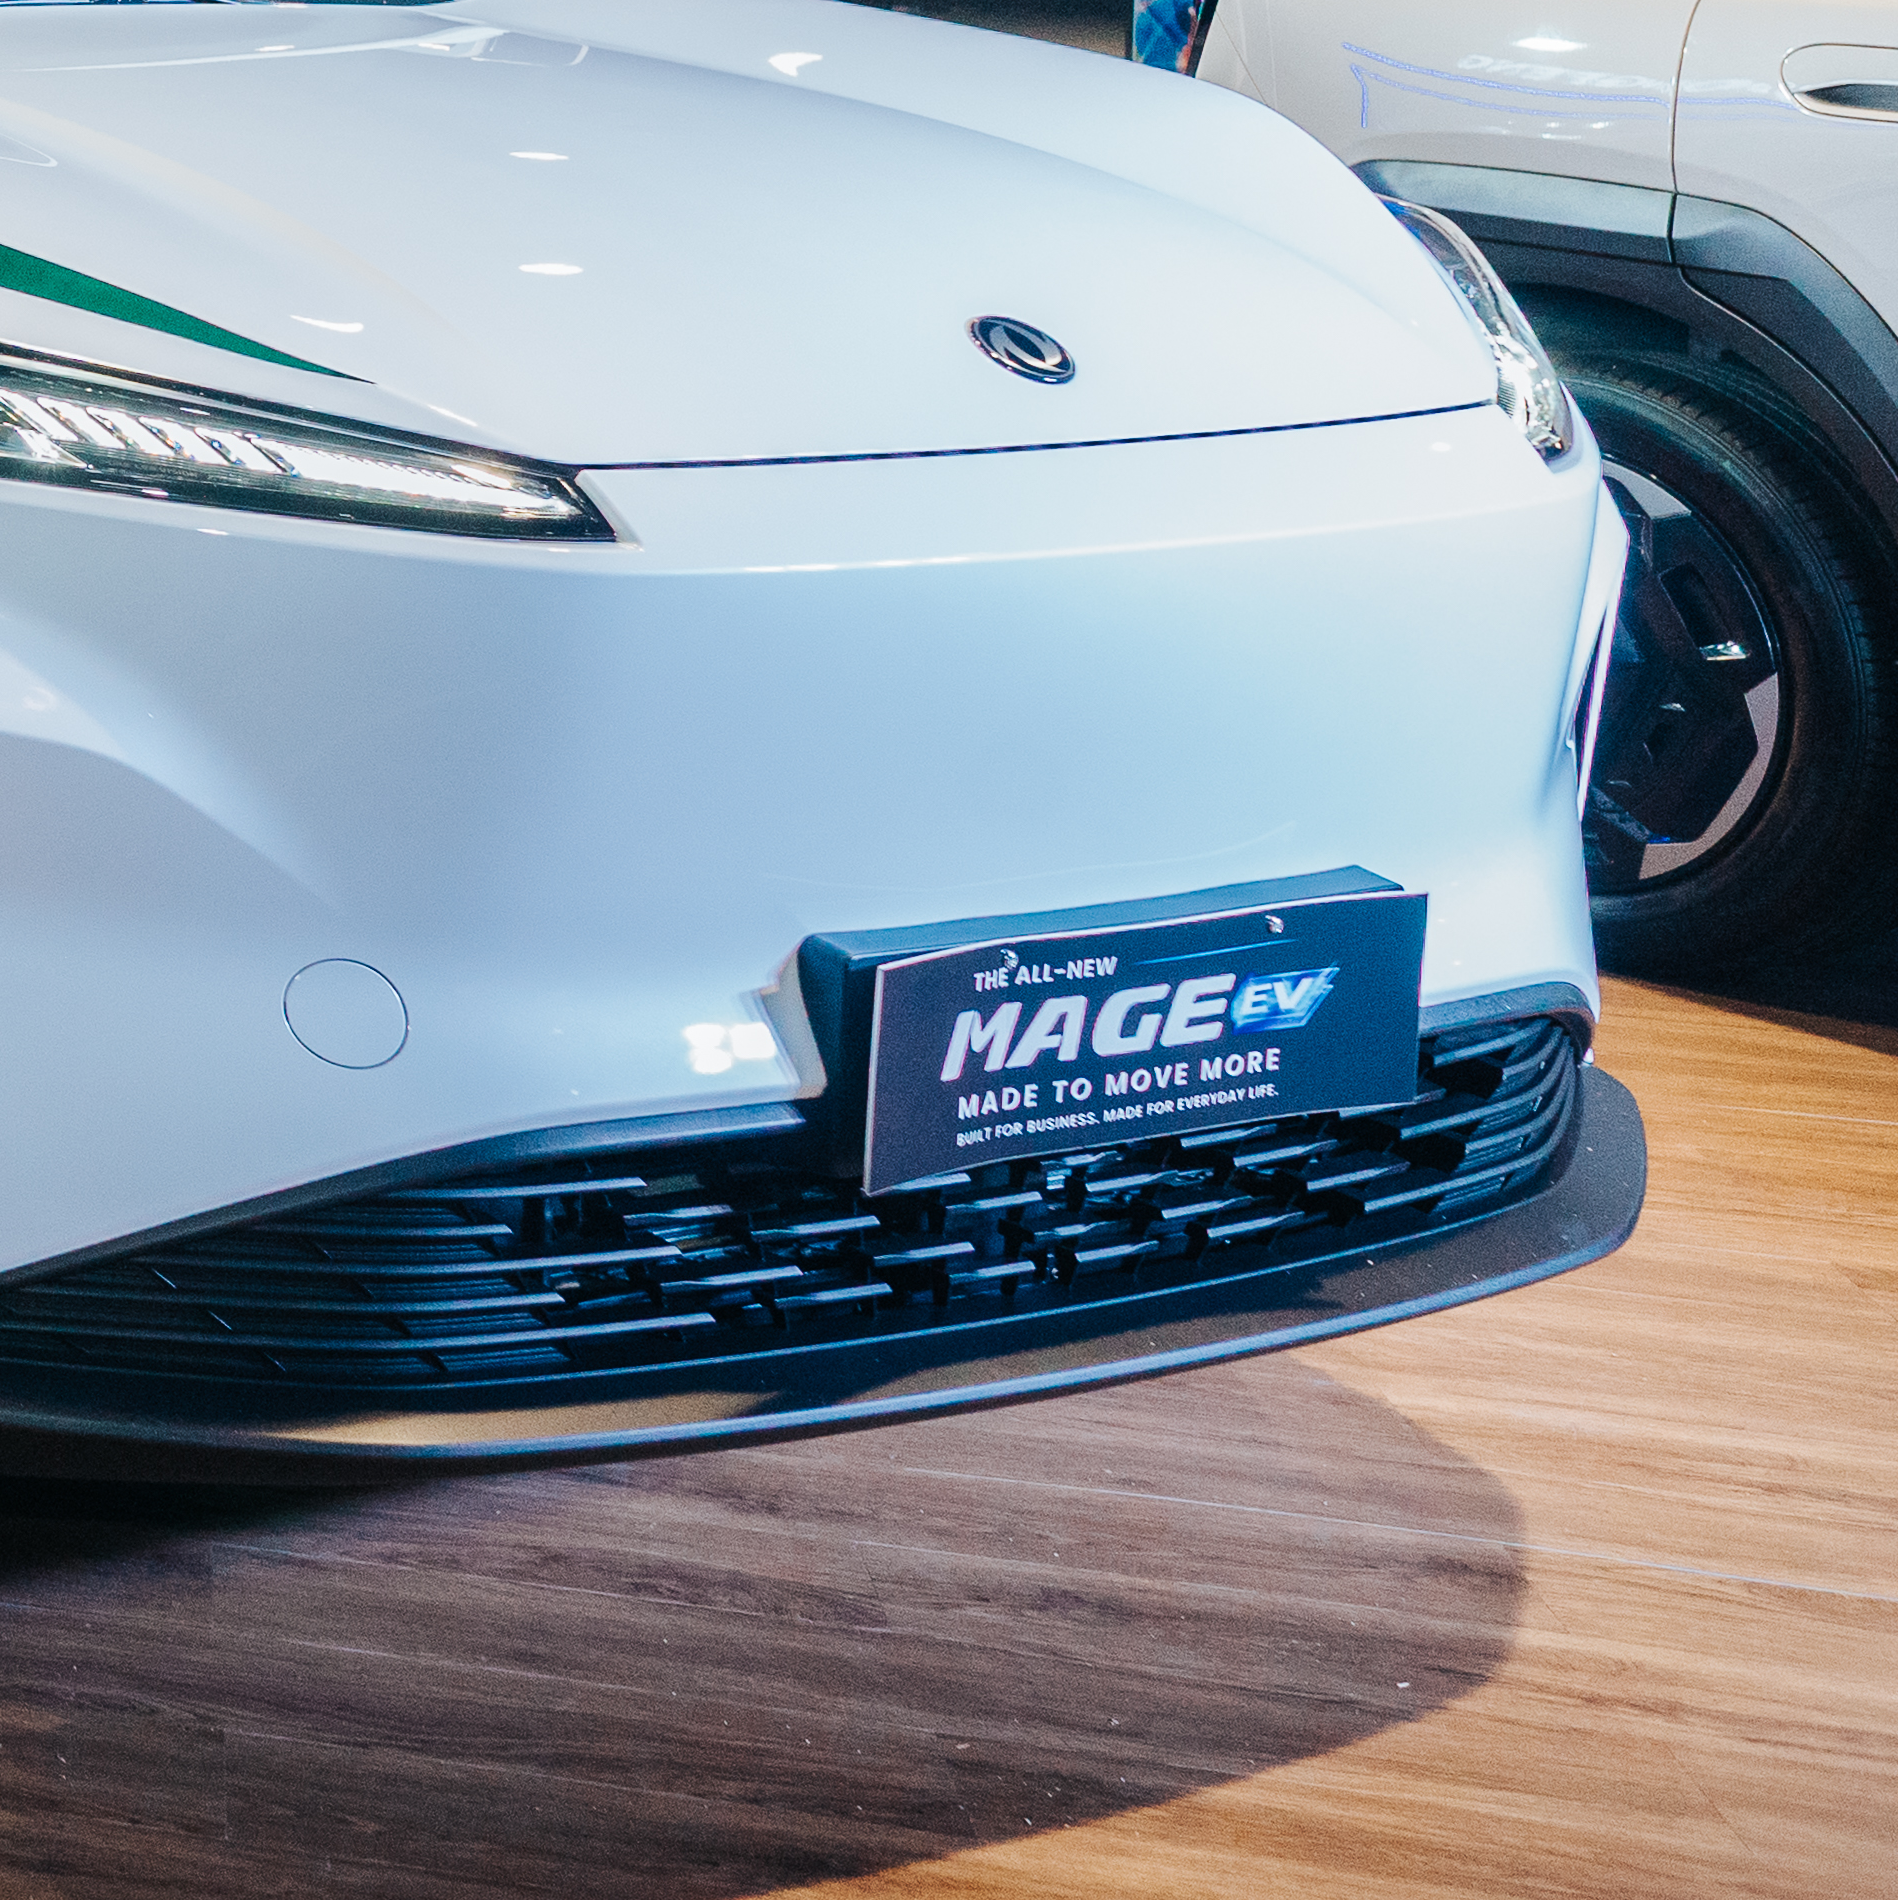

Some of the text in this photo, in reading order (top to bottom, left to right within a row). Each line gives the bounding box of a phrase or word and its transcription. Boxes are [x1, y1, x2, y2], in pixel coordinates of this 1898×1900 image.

[974, 956, 1118, 992] THE ALL-NEW
[940, 973, 1313, 1082] MAGE EV
[956, 1083, 1279, 1147] BUILT FOR BUSINESS. MADE FOR EVERYDAY LIFE.
[958, 1047, 1281, 1120] MADE TO MOVE MORE
